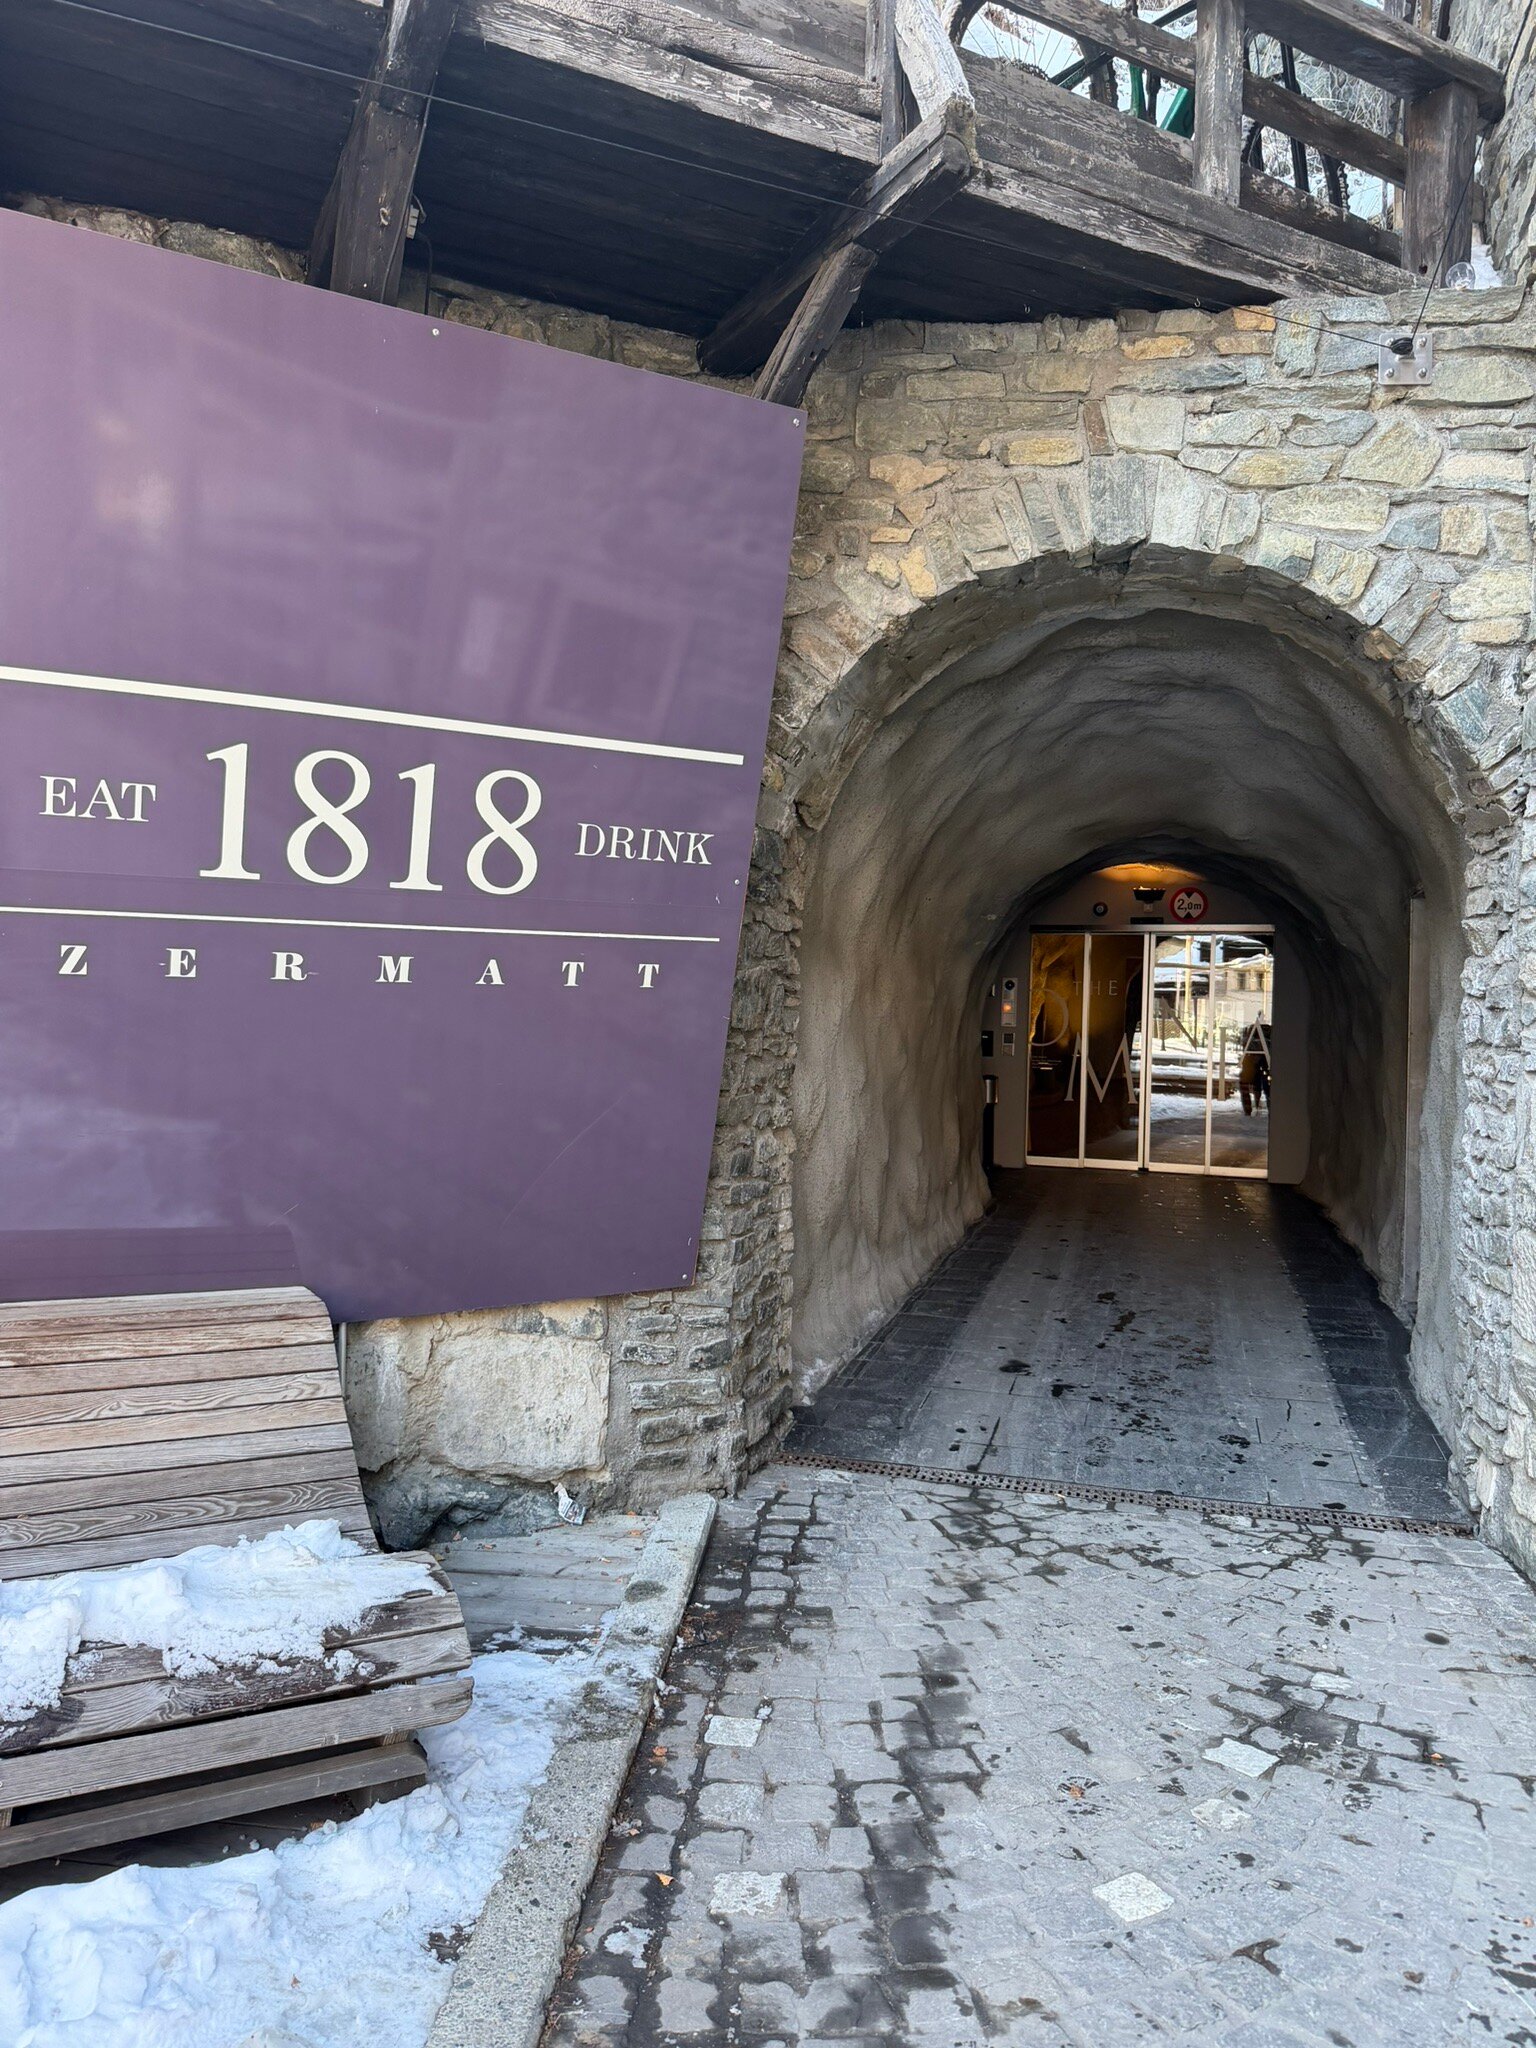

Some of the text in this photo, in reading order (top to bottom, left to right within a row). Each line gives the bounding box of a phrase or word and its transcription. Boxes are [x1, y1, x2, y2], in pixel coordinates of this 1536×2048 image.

[38, 742, 716, 896] EAT 1818 DRINK
[1177, 898, 1202, 912] 2,0m
[57, 943, 661, 989] ZERMATT
